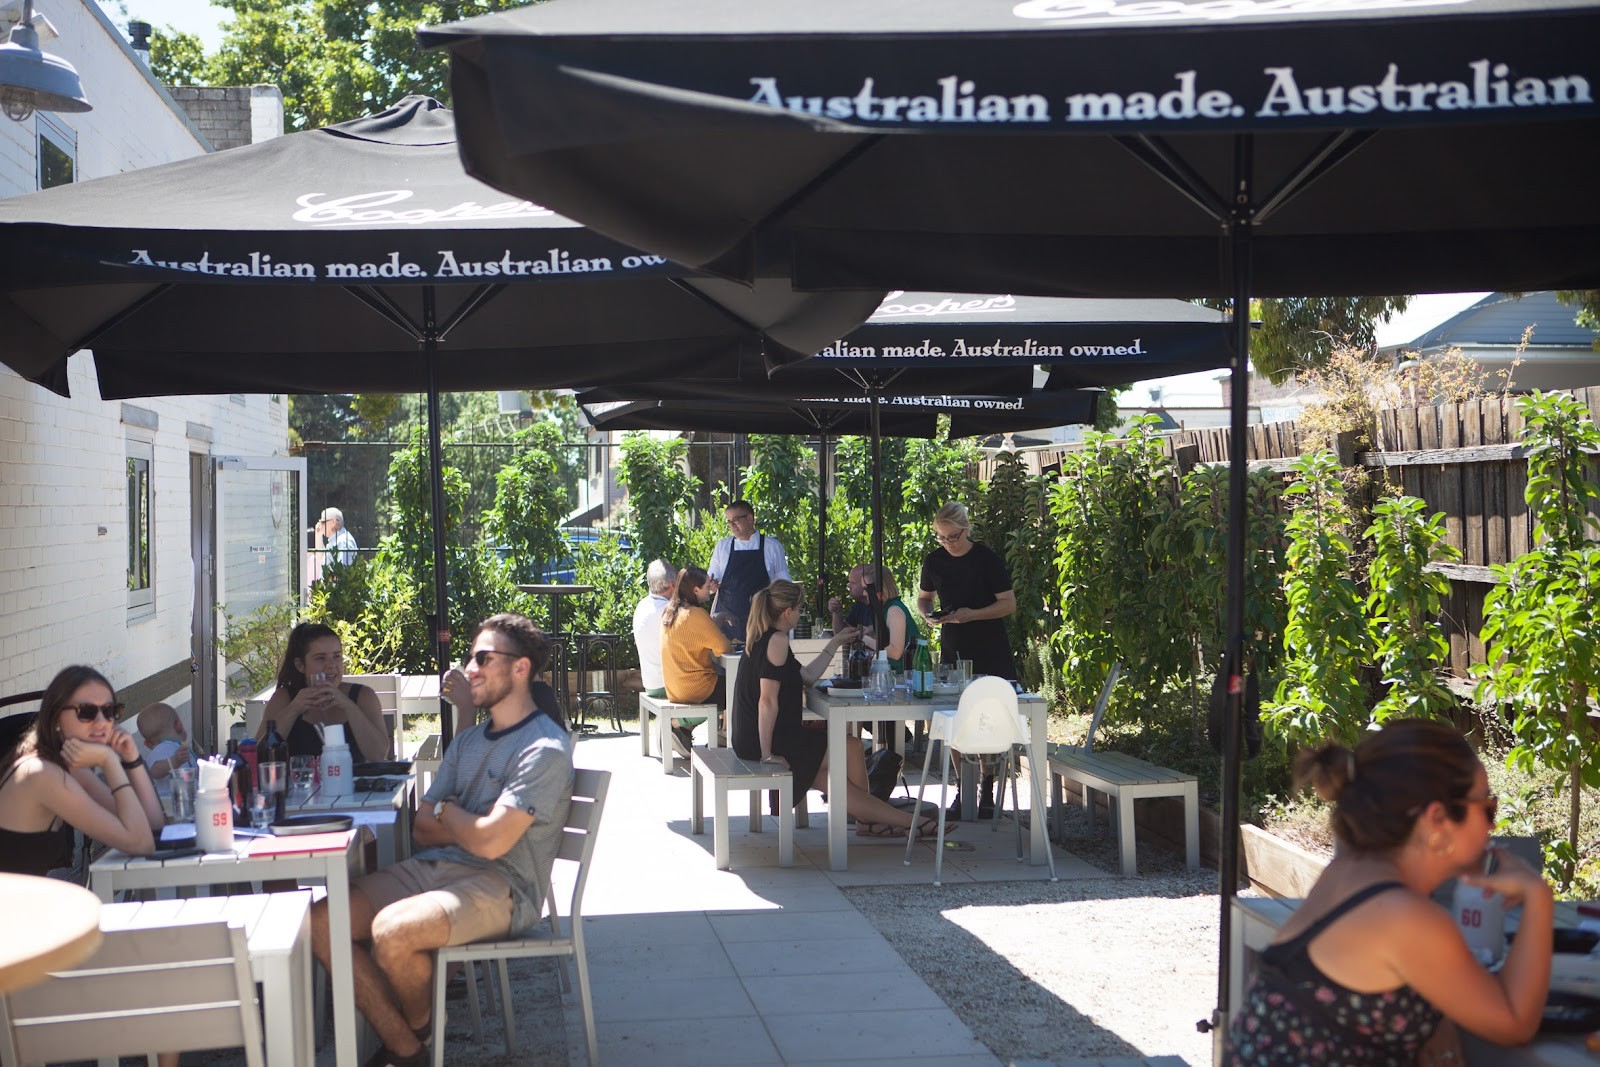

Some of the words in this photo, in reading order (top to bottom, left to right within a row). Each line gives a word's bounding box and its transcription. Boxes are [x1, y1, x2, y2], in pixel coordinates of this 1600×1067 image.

[748, 76, 1050, 122] Australian
[1065, 70, 1245, 121] made.
[1256, 58, 1592, 118] Australian
[129, 250, 317, 278] Australian
[324, 251, 428, 278] made.
[433, 247, 613, 277] Australian
[868, 290, 1017, 318] oopers
[814, 339, 877, 358] alian
[881, 339, 947, 358] made.
[949, 338, 1064, 358] Australian
[1069, 338, 1147, 358] owned.
[890, 394, 971, 408] Australian
[973, 396, 1024, 411] owned.
[213, 812, 227, 826] 59
[1461, 908, 1482, 928] 60
